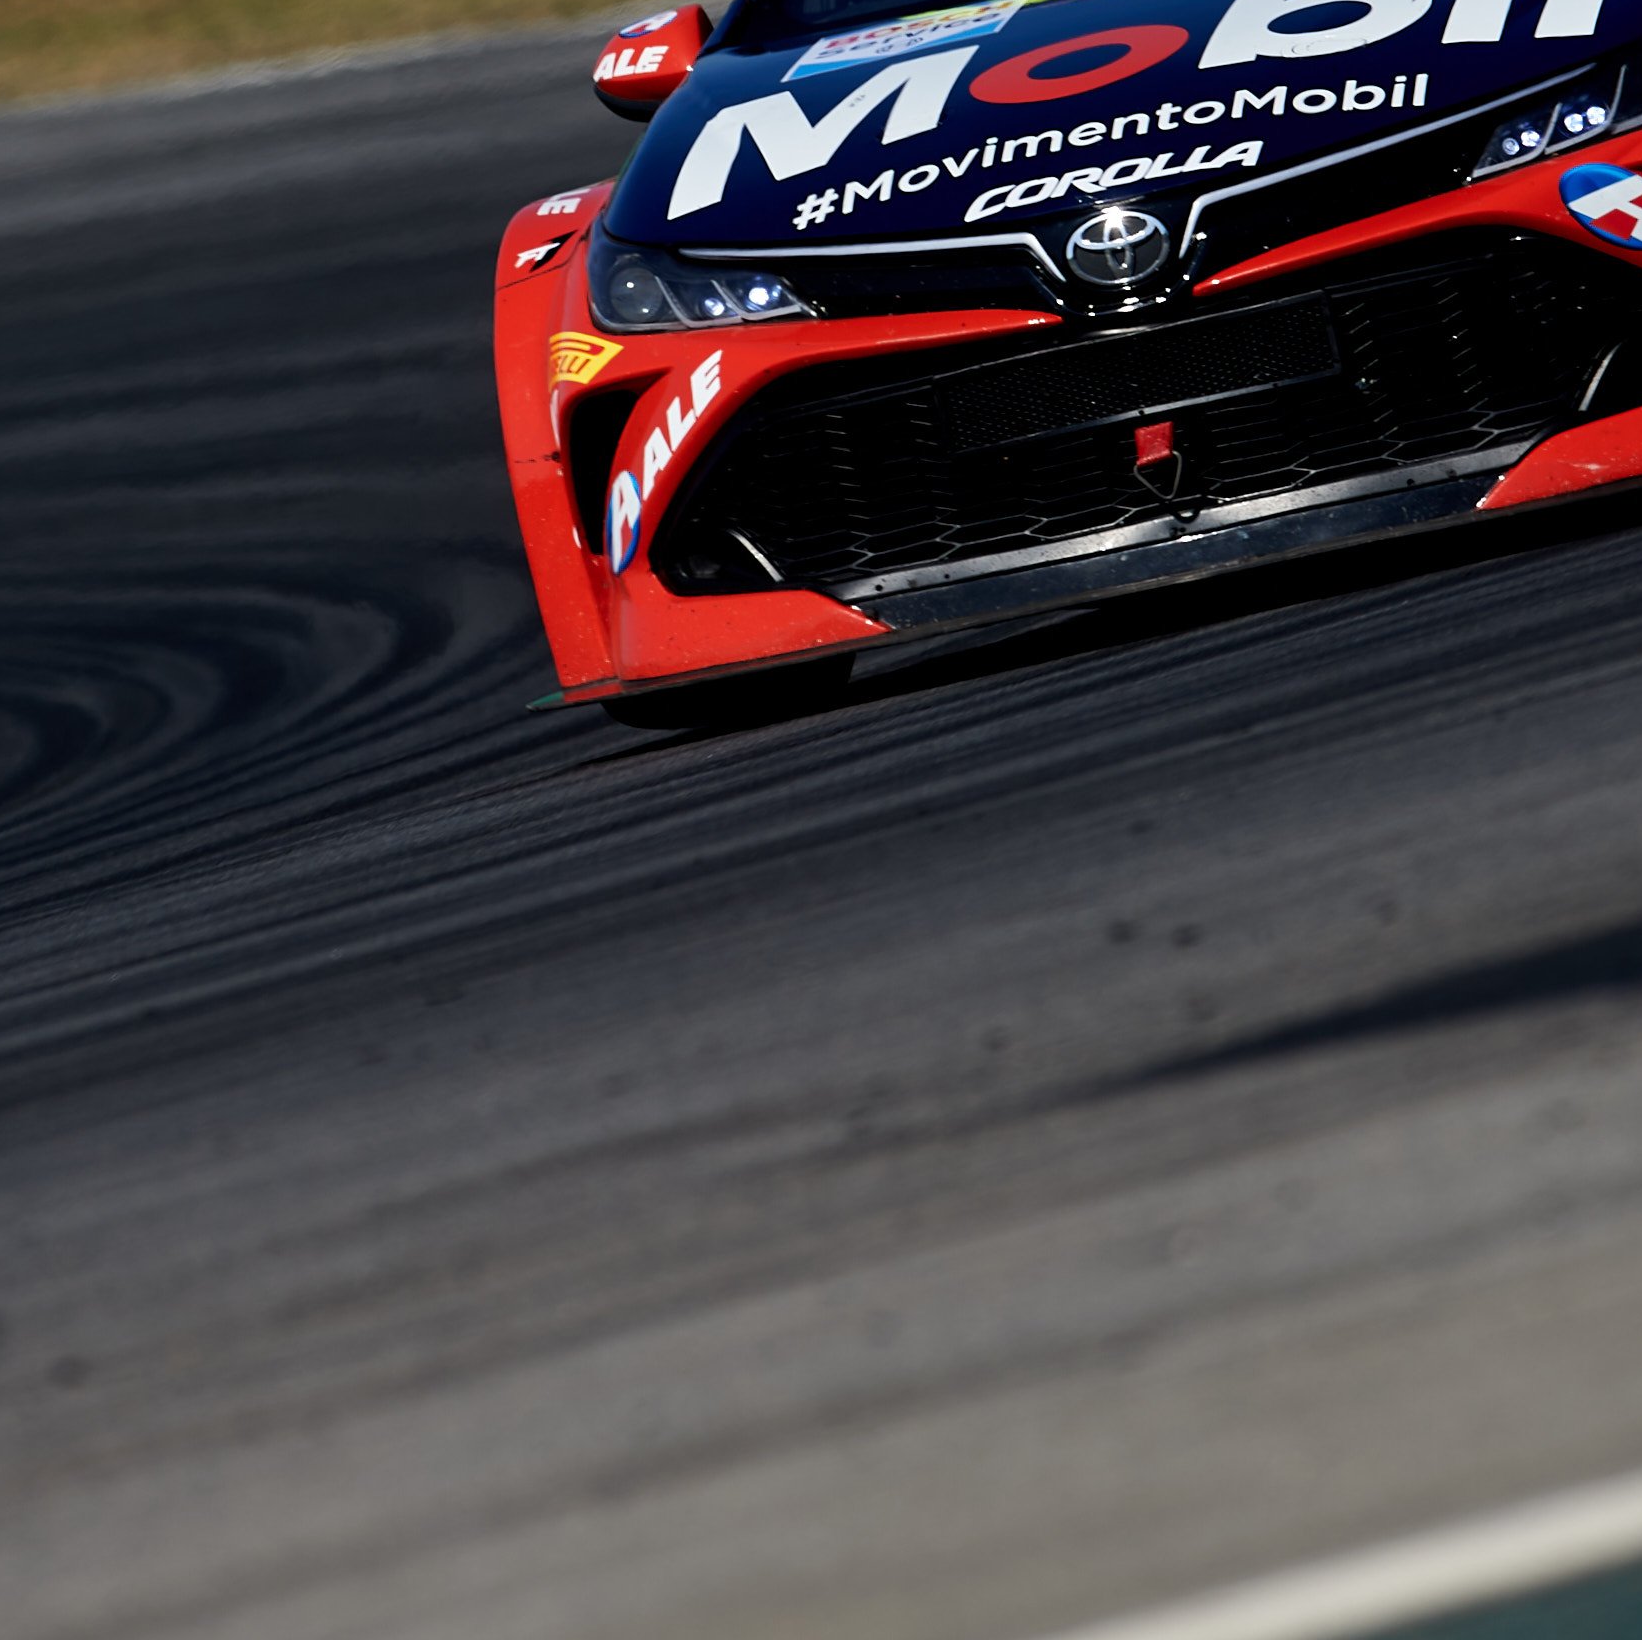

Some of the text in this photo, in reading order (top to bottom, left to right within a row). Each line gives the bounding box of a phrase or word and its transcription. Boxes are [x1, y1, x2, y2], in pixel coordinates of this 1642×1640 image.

[595, 45, 670, 82] ALE
[824, 1, 1014, 50] BOSCH
[790, 72, 1429, 231] #MovimentoMobil
[963, 140, 1264, 224] COROLLA
[642, 349, 724, 502] ALE
